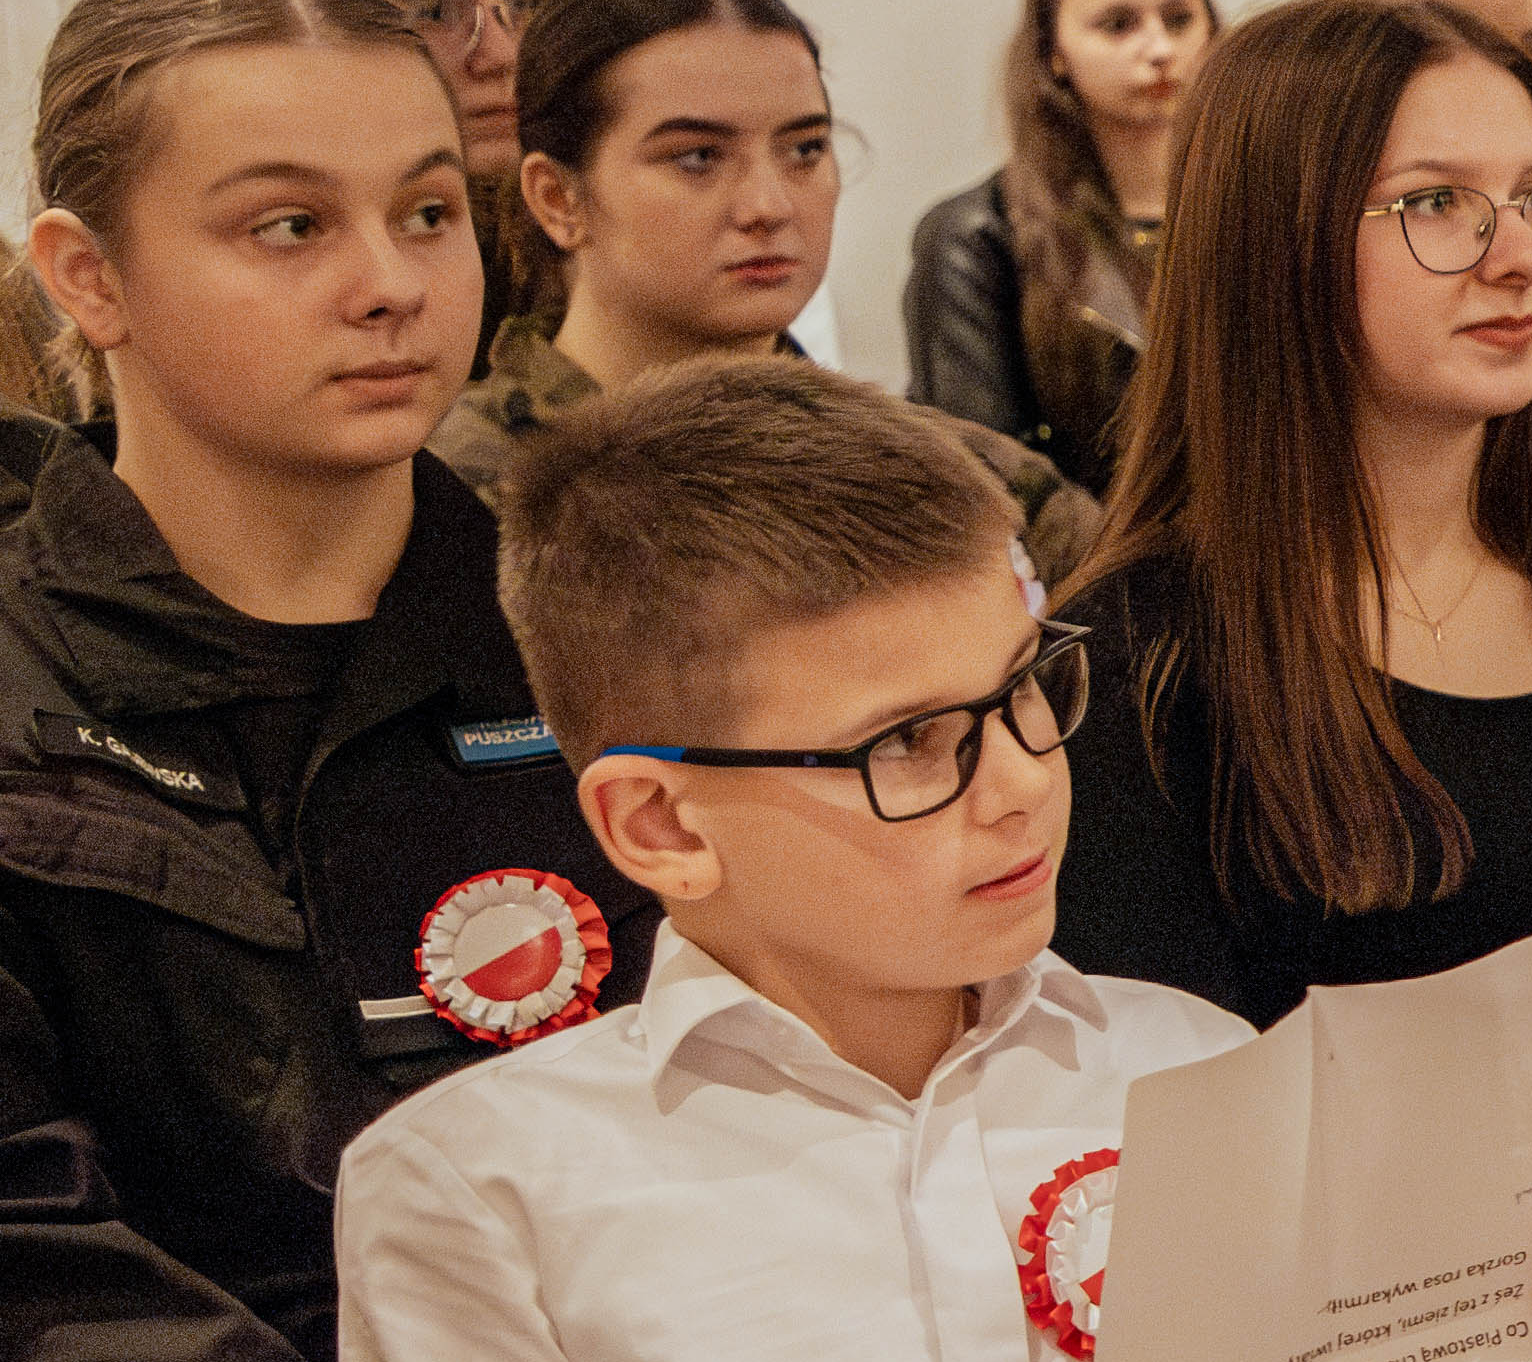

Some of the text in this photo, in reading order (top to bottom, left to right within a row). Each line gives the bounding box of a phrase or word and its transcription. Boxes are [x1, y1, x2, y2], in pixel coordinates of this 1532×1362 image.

[1465, 1250, 1528, 1278] Gorzka
[1422, 1268, 1461, 1291] rosa
[1480, 1292, 1492, 1306] z
[1491, 1282, 1525, 1305] Żeś
[1451, 1296, 1480, 1318] tej
[1396, 1305, 1452, 1333] ziemi,
[1505, 1320, 1530, 1340] Co
[1336, 1322, 1394, 1351] której
